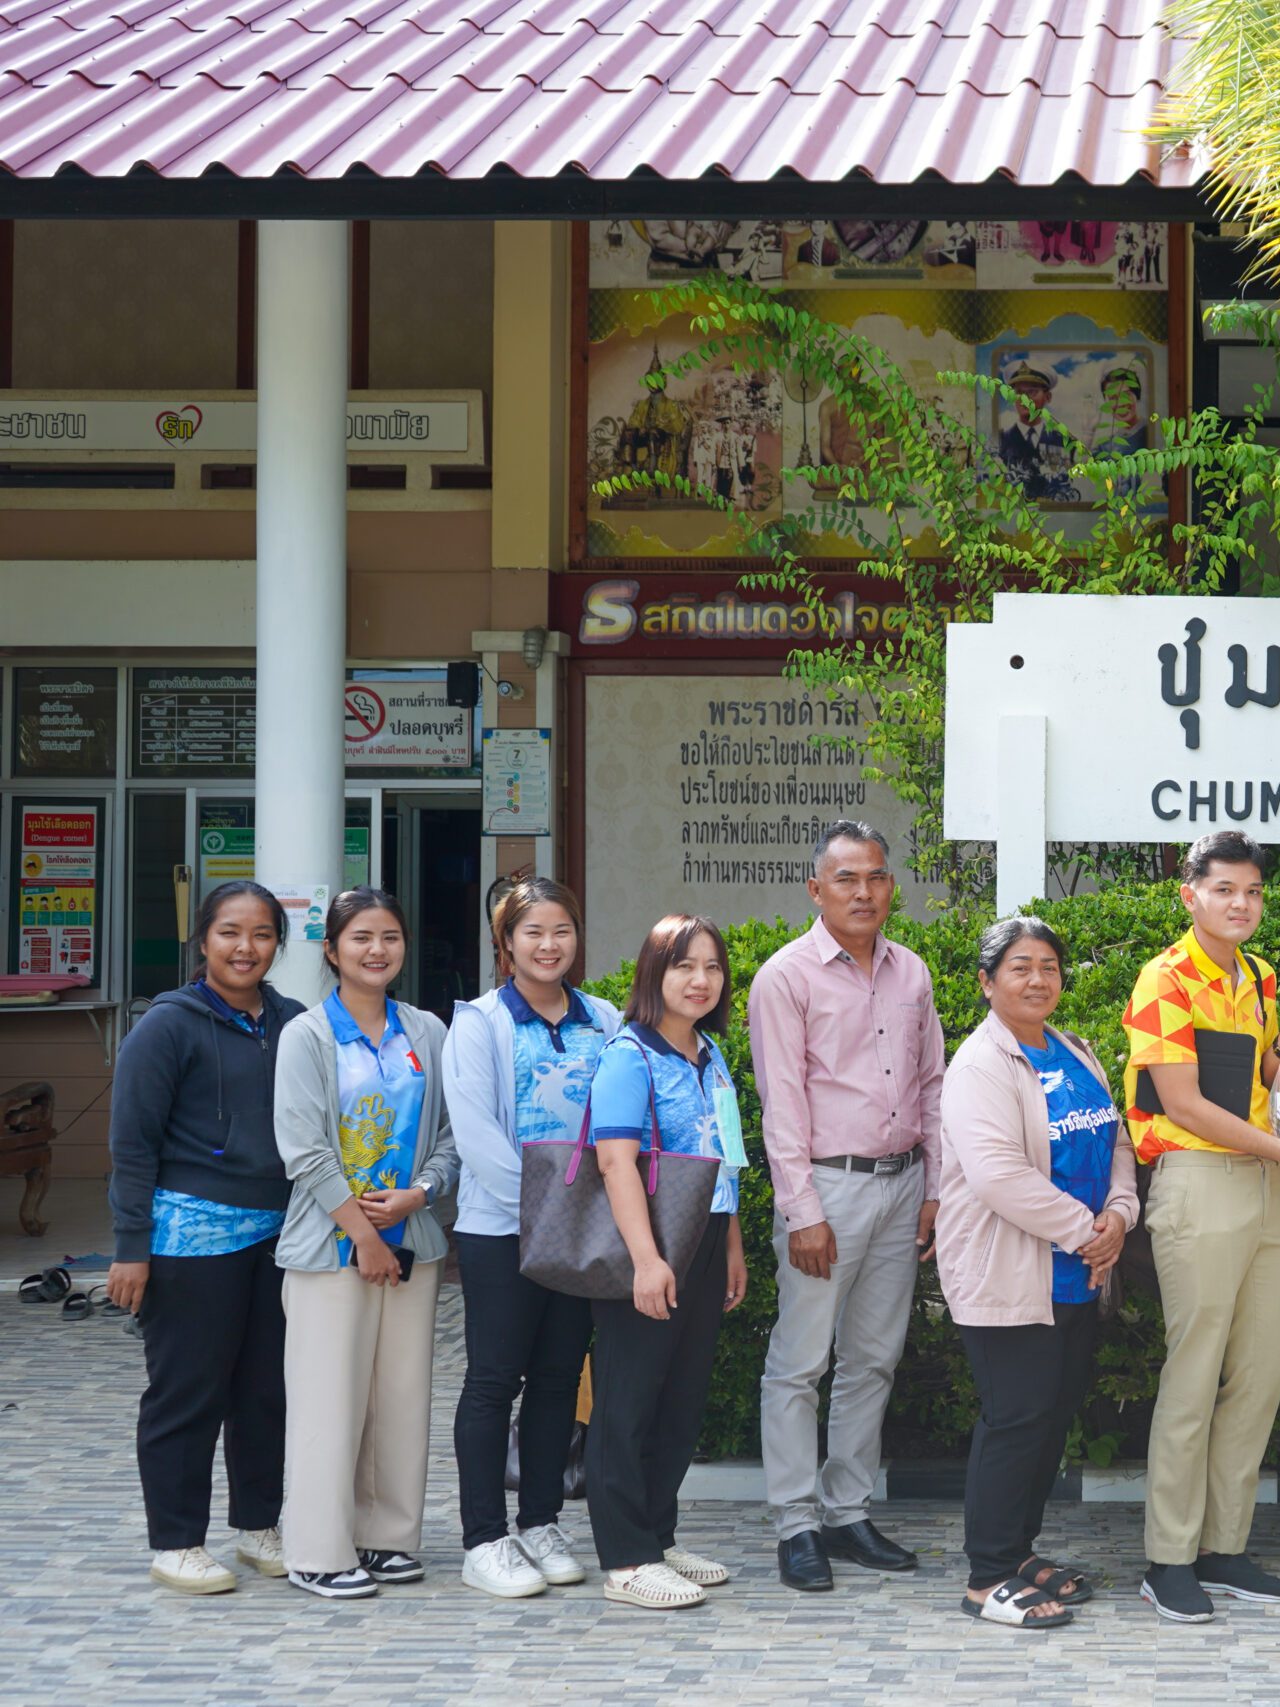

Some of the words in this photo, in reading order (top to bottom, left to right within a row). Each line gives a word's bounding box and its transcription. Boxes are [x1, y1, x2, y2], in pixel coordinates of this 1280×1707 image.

[162, 415, 194, 440] รัก
[390, 713, 464, 742] ปลอดบุหรี่
[680, 767, 867, 814] ประโยชน์ของเพื่อนมนุษย
